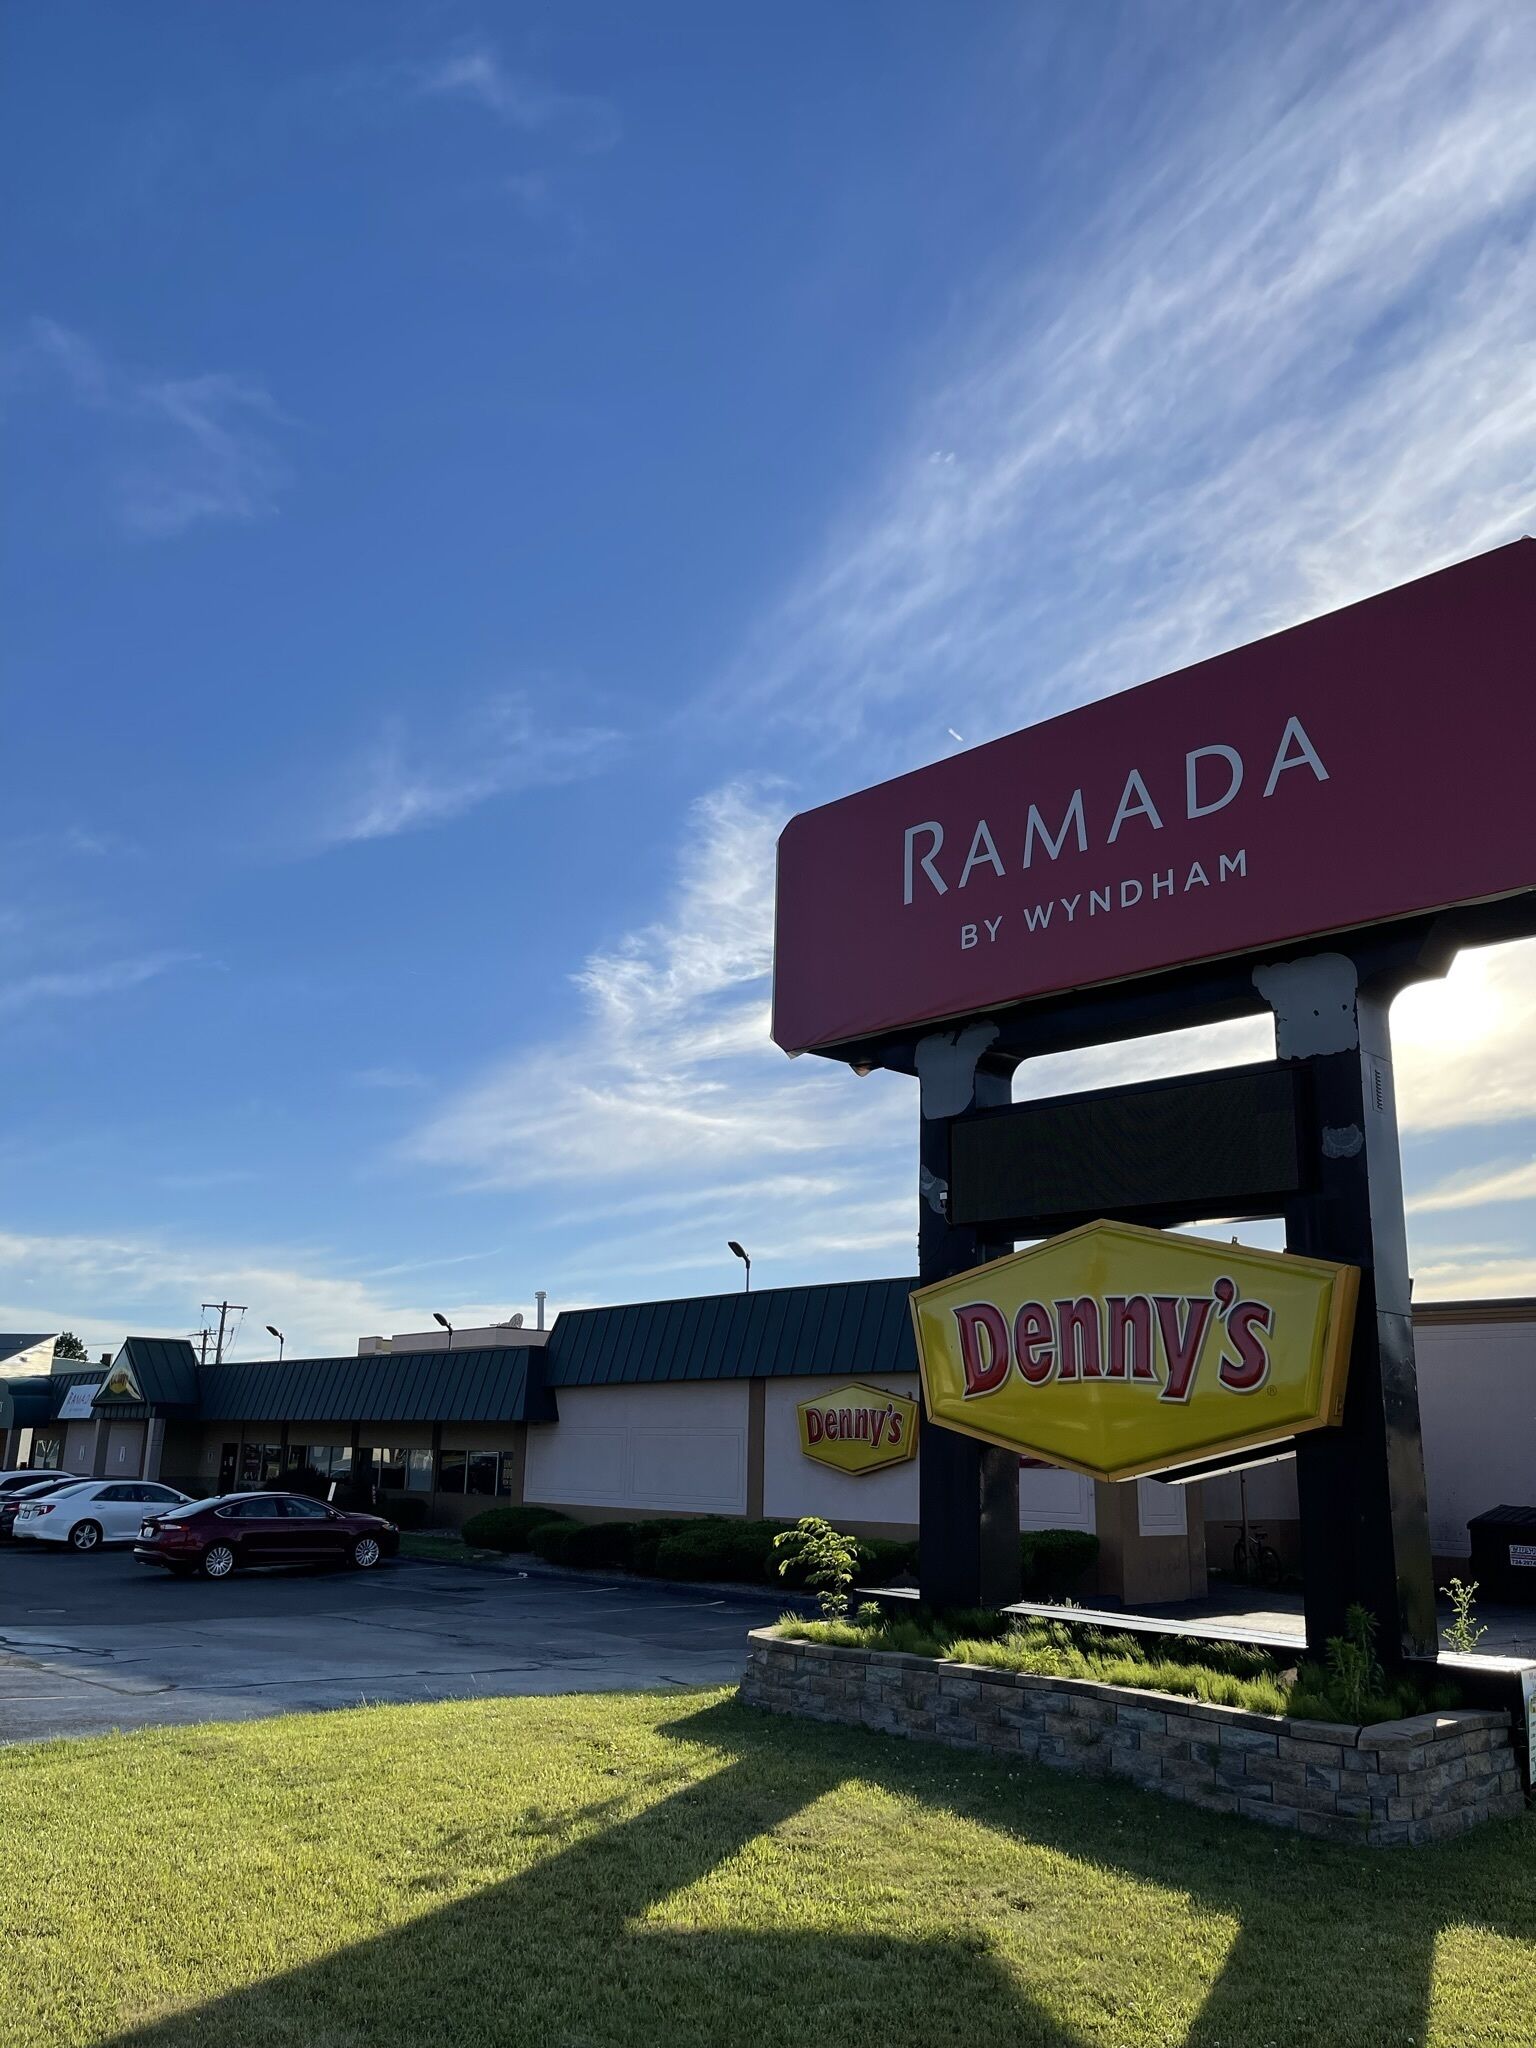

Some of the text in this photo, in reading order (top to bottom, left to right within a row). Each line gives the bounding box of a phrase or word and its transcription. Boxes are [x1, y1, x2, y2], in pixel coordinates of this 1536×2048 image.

[903, 715, 1330, 906] RAMADA
[960, 849, 1248, 950] BY WYNDHAM
[951, 1276, 1274, 1404] Denny's
[805, 1402, 903, 1448] Denny's
